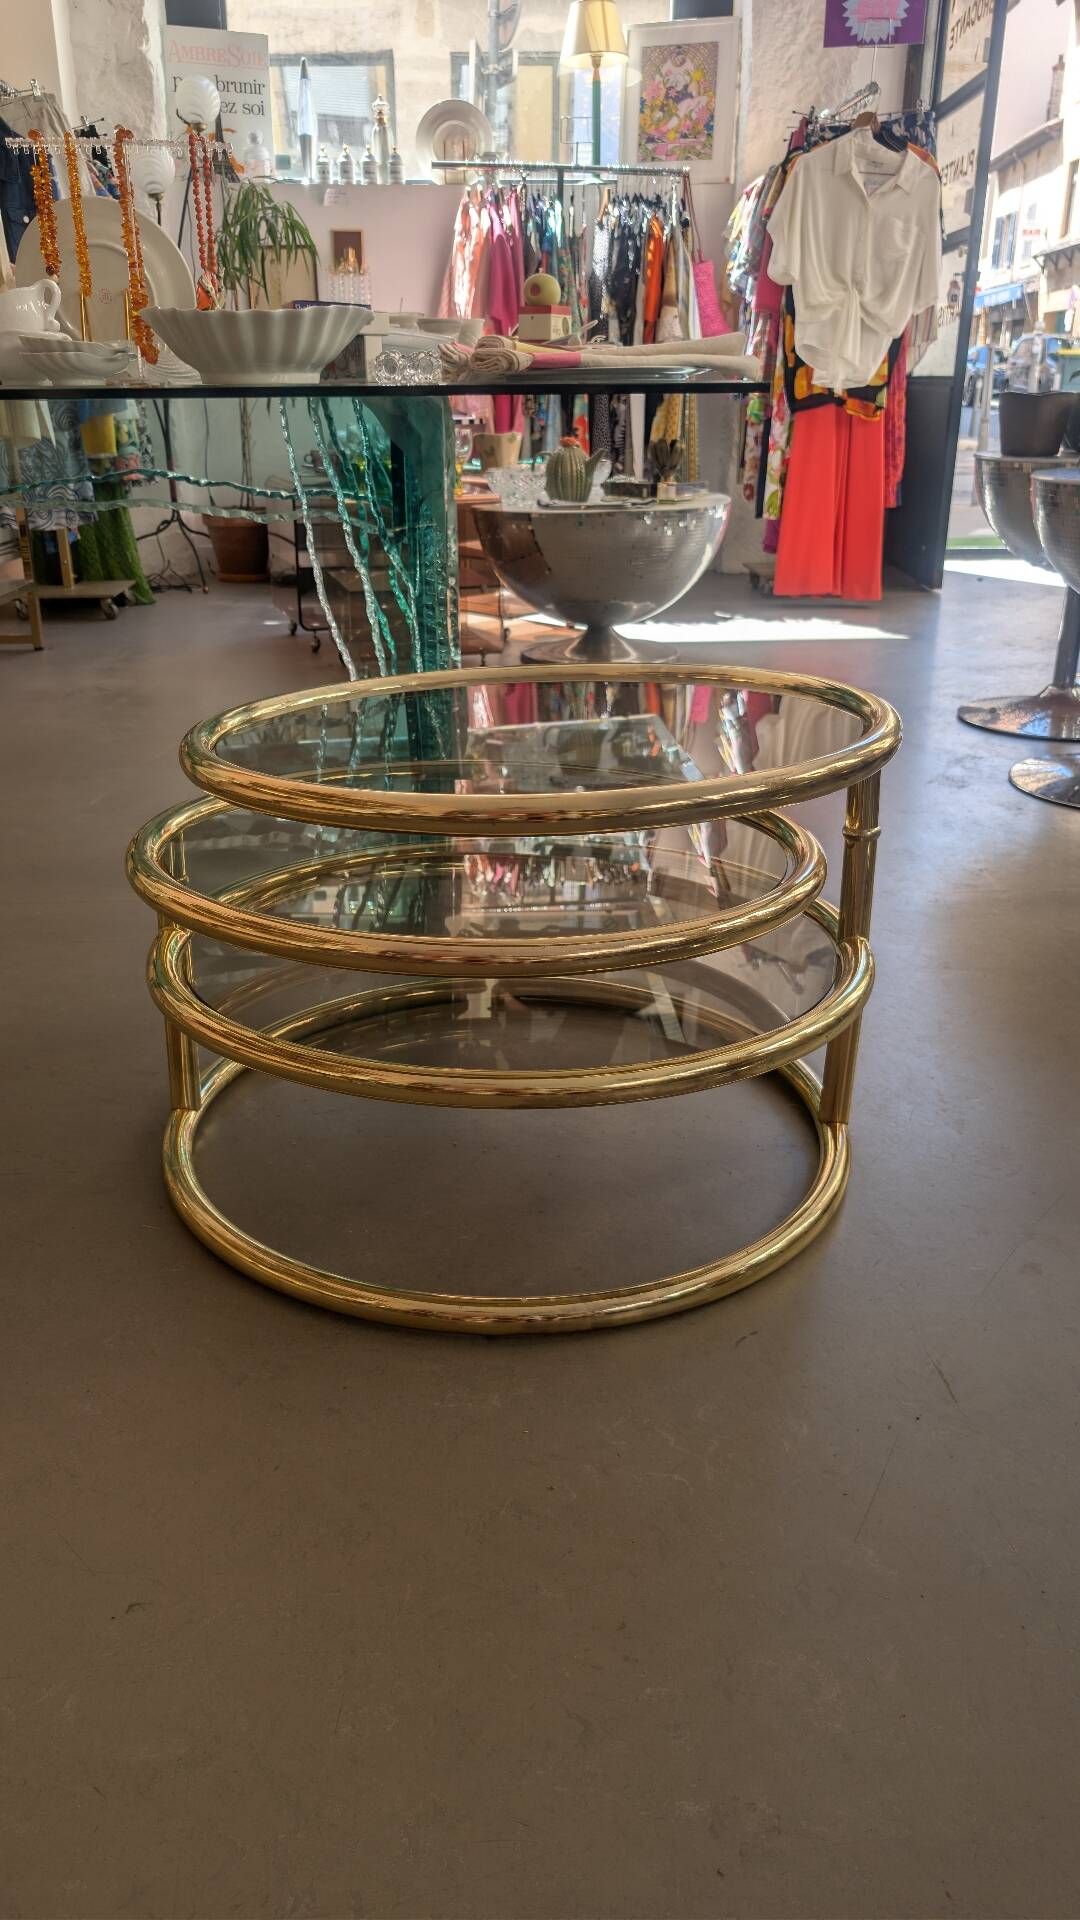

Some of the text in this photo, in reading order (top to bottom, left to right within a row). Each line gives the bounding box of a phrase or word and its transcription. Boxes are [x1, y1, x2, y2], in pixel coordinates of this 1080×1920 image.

[214, 74, 266, 95] brunir
[219, 101, 265, 116] ez soi
